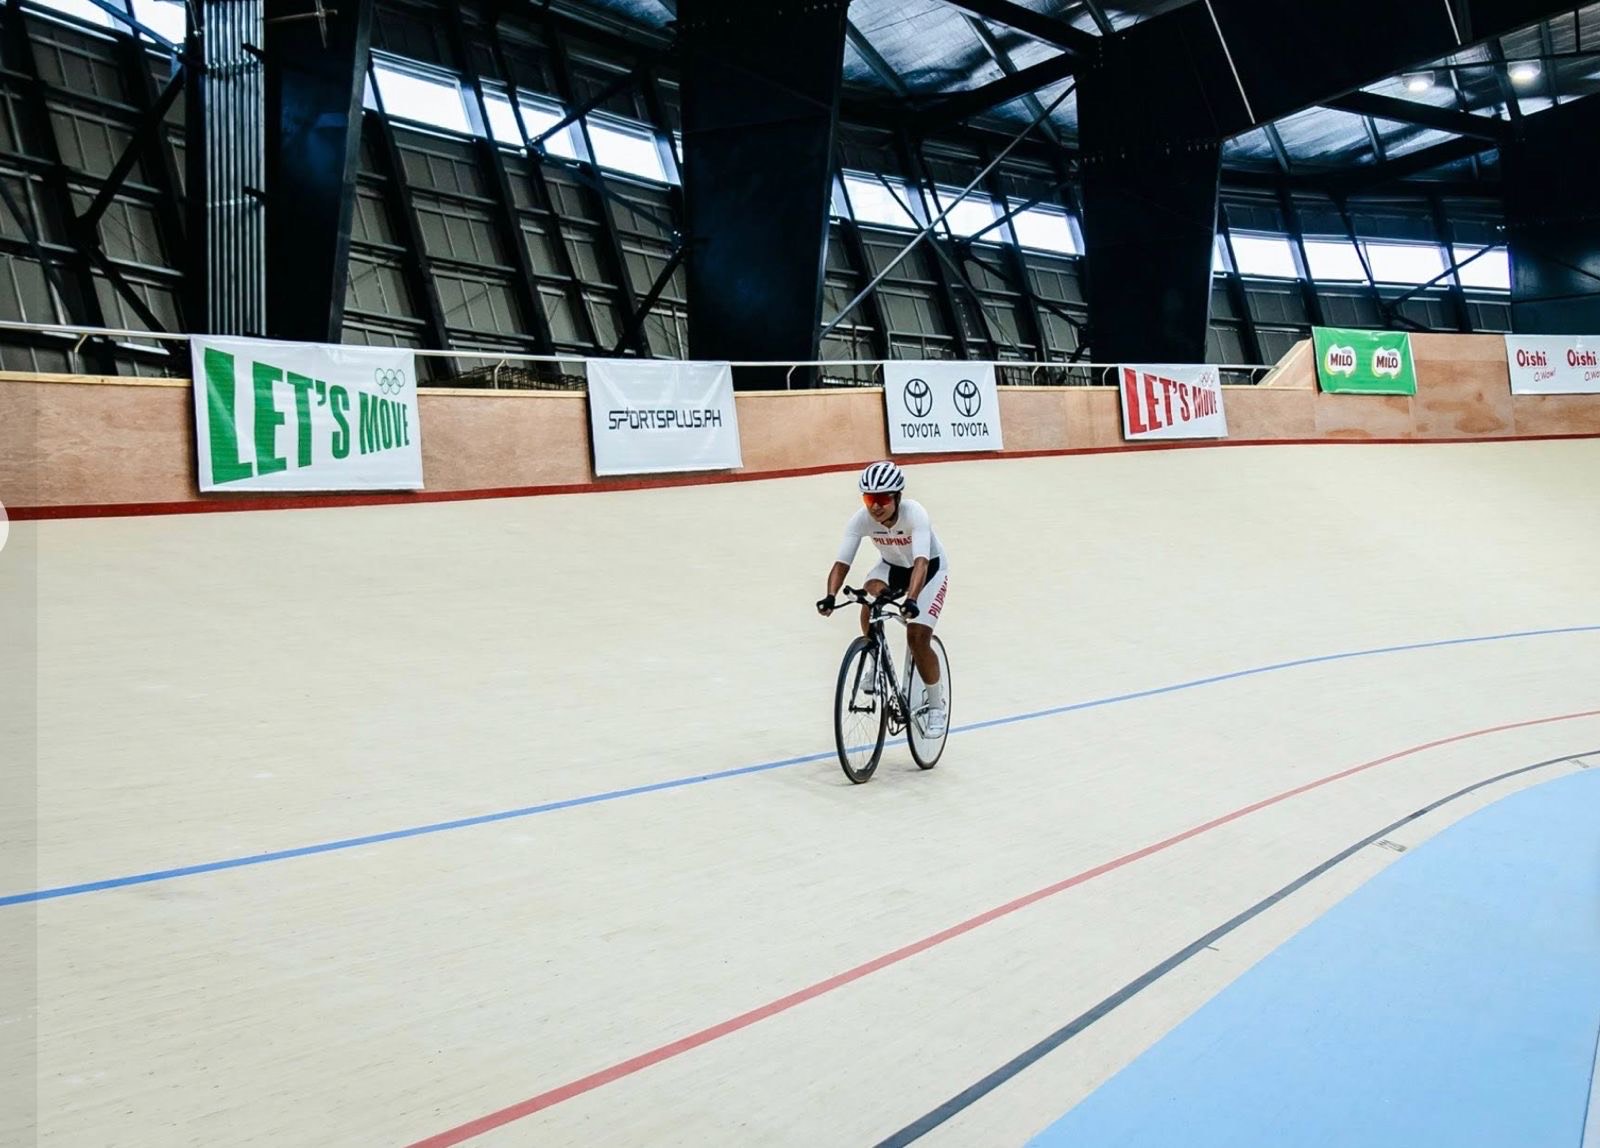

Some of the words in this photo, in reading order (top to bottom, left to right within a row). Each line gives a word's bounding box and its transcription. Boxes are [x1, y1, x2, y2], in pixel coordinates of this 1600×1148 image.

[1330, 353, 1353, 366] MILO
[1376, 355, 1398, 368] MILO
[1517, 349, 1547, 367] Oishi
[1567, 349, 1597, 367] Oishi
[1123, 367, 1190, 435] LET'S
[1192, 385, 1218, 419] MOVE
[205, 347, 350, 485] LET'S
[359, 391, 410, 455] MOVE
[608, 407, 722, 430] SPORTSPLUS.PH
[901, 423, 941, 438] TOYOTA
[951, 423, 989, 437] TOYOTA
